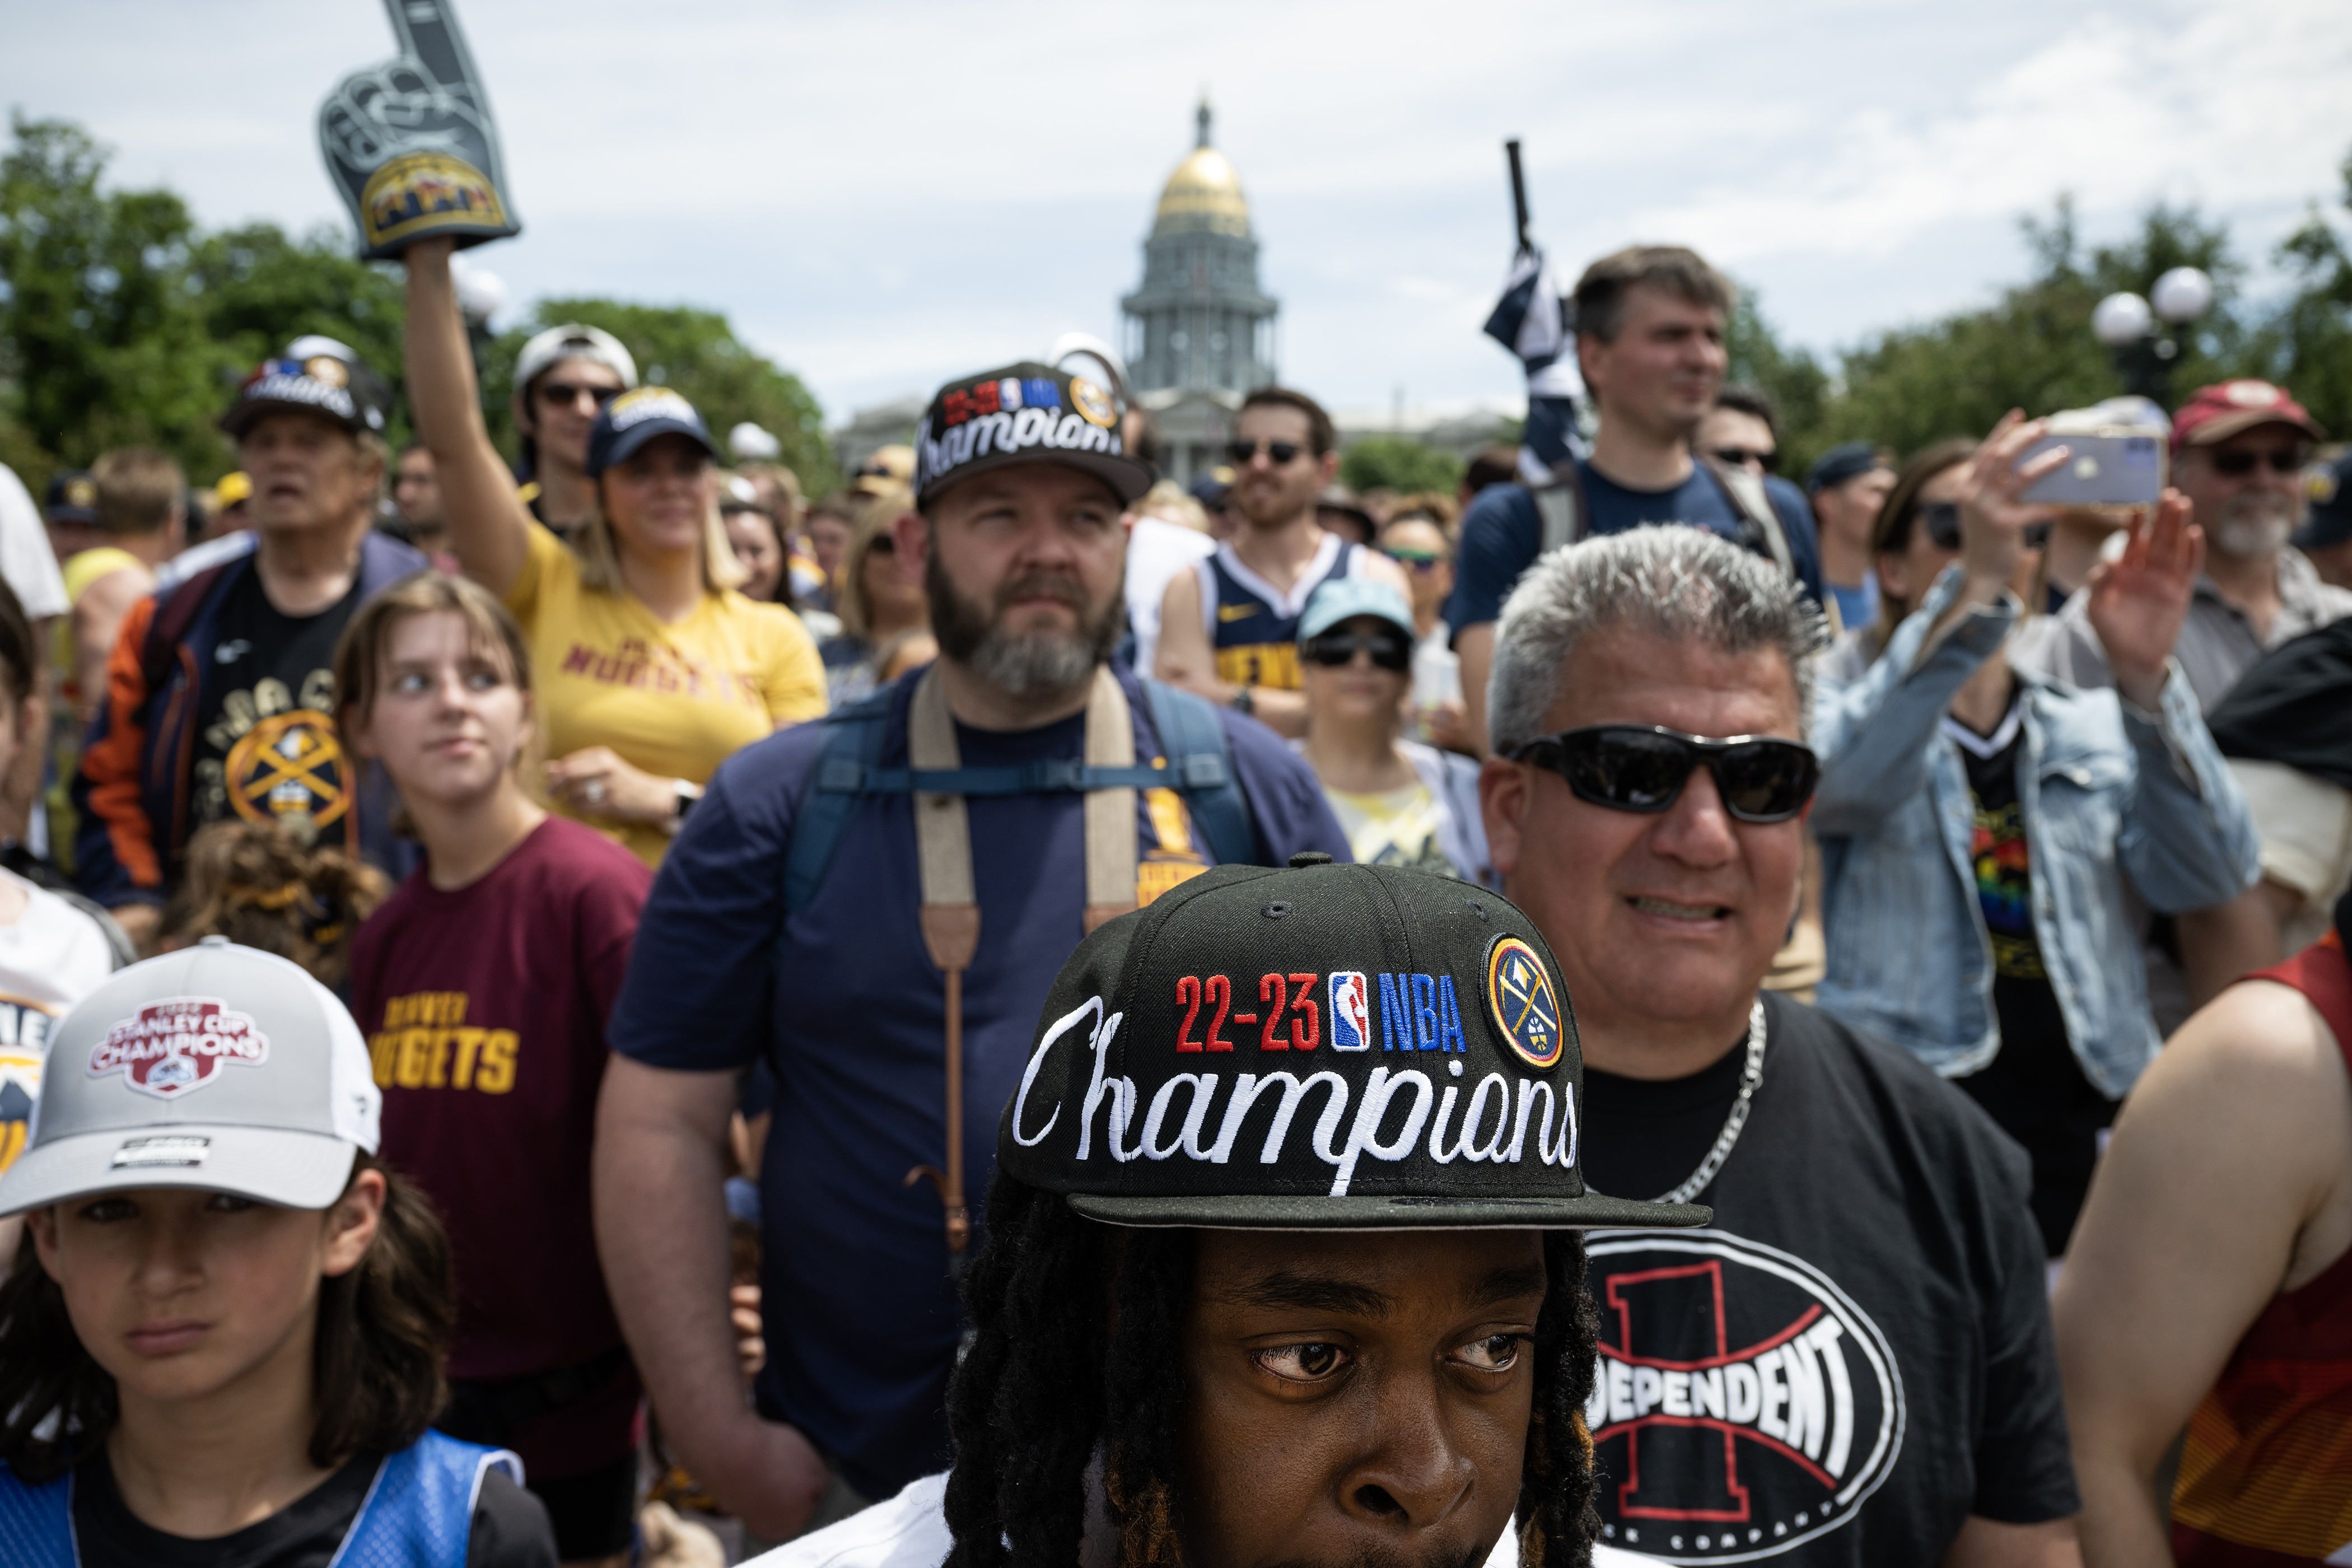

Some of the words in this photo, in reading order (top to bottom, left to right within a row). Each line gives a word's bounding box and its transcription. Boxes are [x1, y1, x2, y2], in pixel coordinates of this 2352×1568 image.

[113, 1014, 203, 1043] STANLEY
[204, 1014, 248, 1035] CUP
[1175, 972, 1319, 1053] 22-23
[1379, 972, 1468, 1052] NBA
[92, 1032, 263, 1069] CHAMPIONS
[1012, 995, 1578, 1197] Champions
[1585, 1314, 1854, 1480] DEPENDENT
[1670, 1500, 1833, 1551] COMPANY
